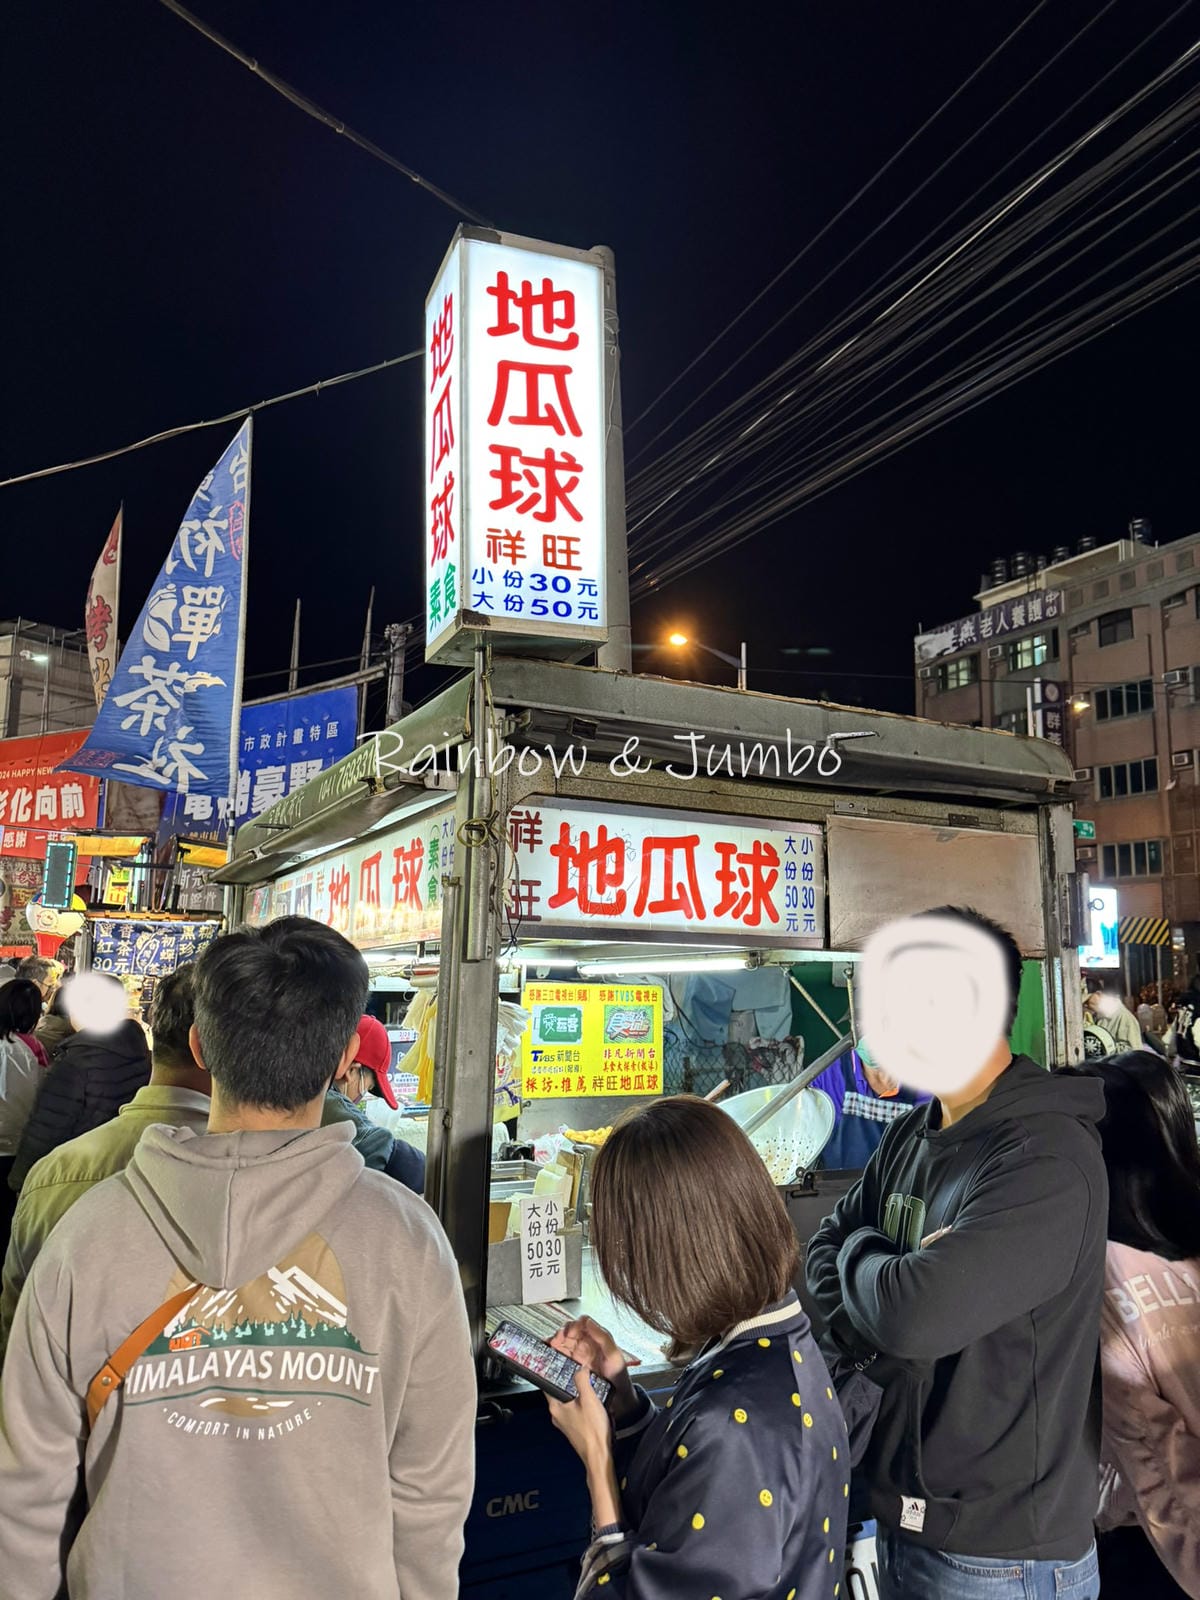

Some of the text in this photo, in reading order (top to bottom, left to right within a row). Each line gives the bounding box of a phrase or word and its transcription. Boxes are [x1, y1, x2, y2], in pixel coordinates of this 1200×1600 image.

[485, 270, 584, 524] 地瓜球
[430, 292, 455, 569] 地瓜球
[486, 527, 583, 572] 祥旺
[429, 562, 457, 633] 素食
[472, 566, 599, 598] 小份30元
[472, 590, 600, 621] 大份50元
[243, 720, 340, 753] 市政計畫特區
[11, 768, 35, 779] HAPPY
[37, 766, 55, 776] NEW
[548, 822, 782, 926] 地瓜球
[784, 835, 800, 933] 大份50元
[801, 834, 817, 933] 小份30元
[527, 1203, 544, 1280] 大份50元
[545, 1200, 562, 1276] 小份30元
[280, 1350, 381, 1395] MOUNT
[167, 1408, 313, 1441] COMFORT IN NATURE
[485, 1488, 540, 1518] CMC
